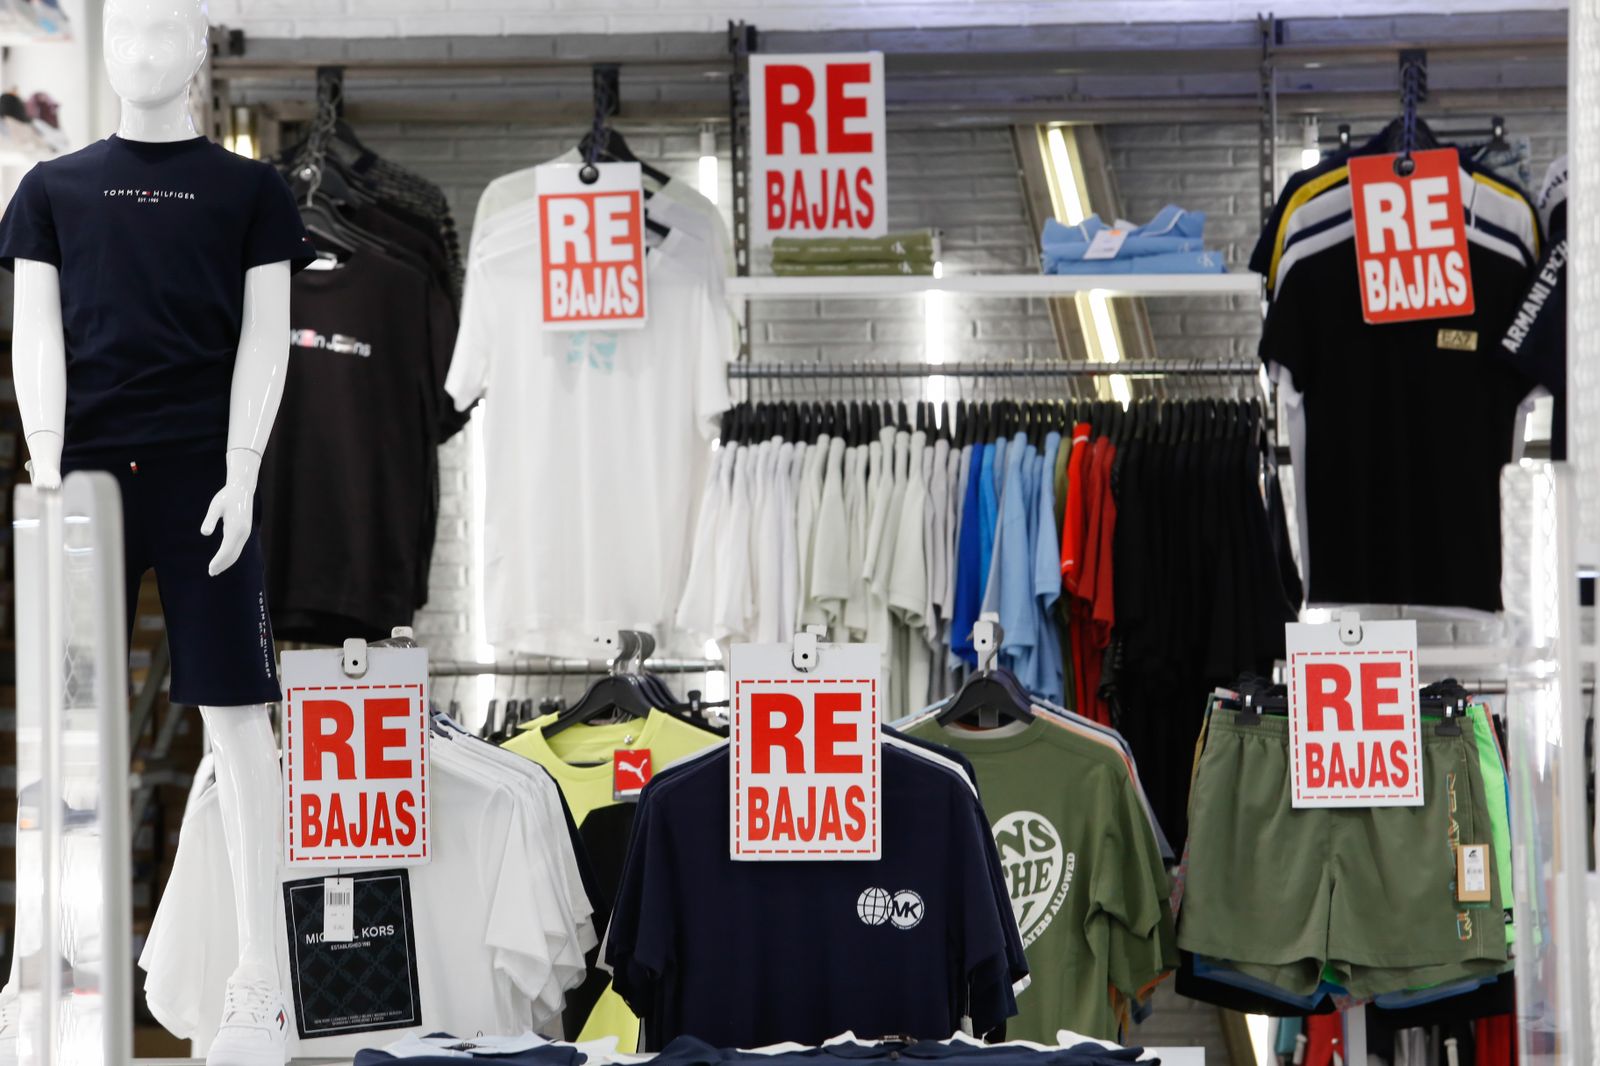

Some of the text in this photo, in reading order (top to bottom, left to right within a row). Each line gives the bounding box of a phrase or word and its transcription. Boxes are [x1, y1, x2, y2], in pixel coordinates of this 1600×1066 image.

[765, 63, 873, 155] RE
[103, 189, 195, 200] TOMMY HILFIGER
[767, 167, 875, 230] BAJAS
[1363, 177, 1455, 253] RE
[547, 195, 634, 264] RE
[549, 265, 640, 318] BAJAS
[1364, 252, 1467, 312] BAJAS
[325, 333, 372, 357] Jns
[1501, 282, 1552, 354] ARMANI
[258, 591, 266, 626] TOMMY
[263, 638, 271, 678] HILFIGER
[1305, 663, 1405, 731] RE
[302, 698, 413, 780] RE
[750, 693, 863, 773] RE
[1305, 741, 1409, 788] BAJAS
[301, 790, 417, 848] BAJAS
[748, 786, 867, 841] BAJAS
[891, 900, 921, 920] MK
[1049, 852, 1075, 916] ALLOWED
[305, 924, 395, 944] MICL KORS
